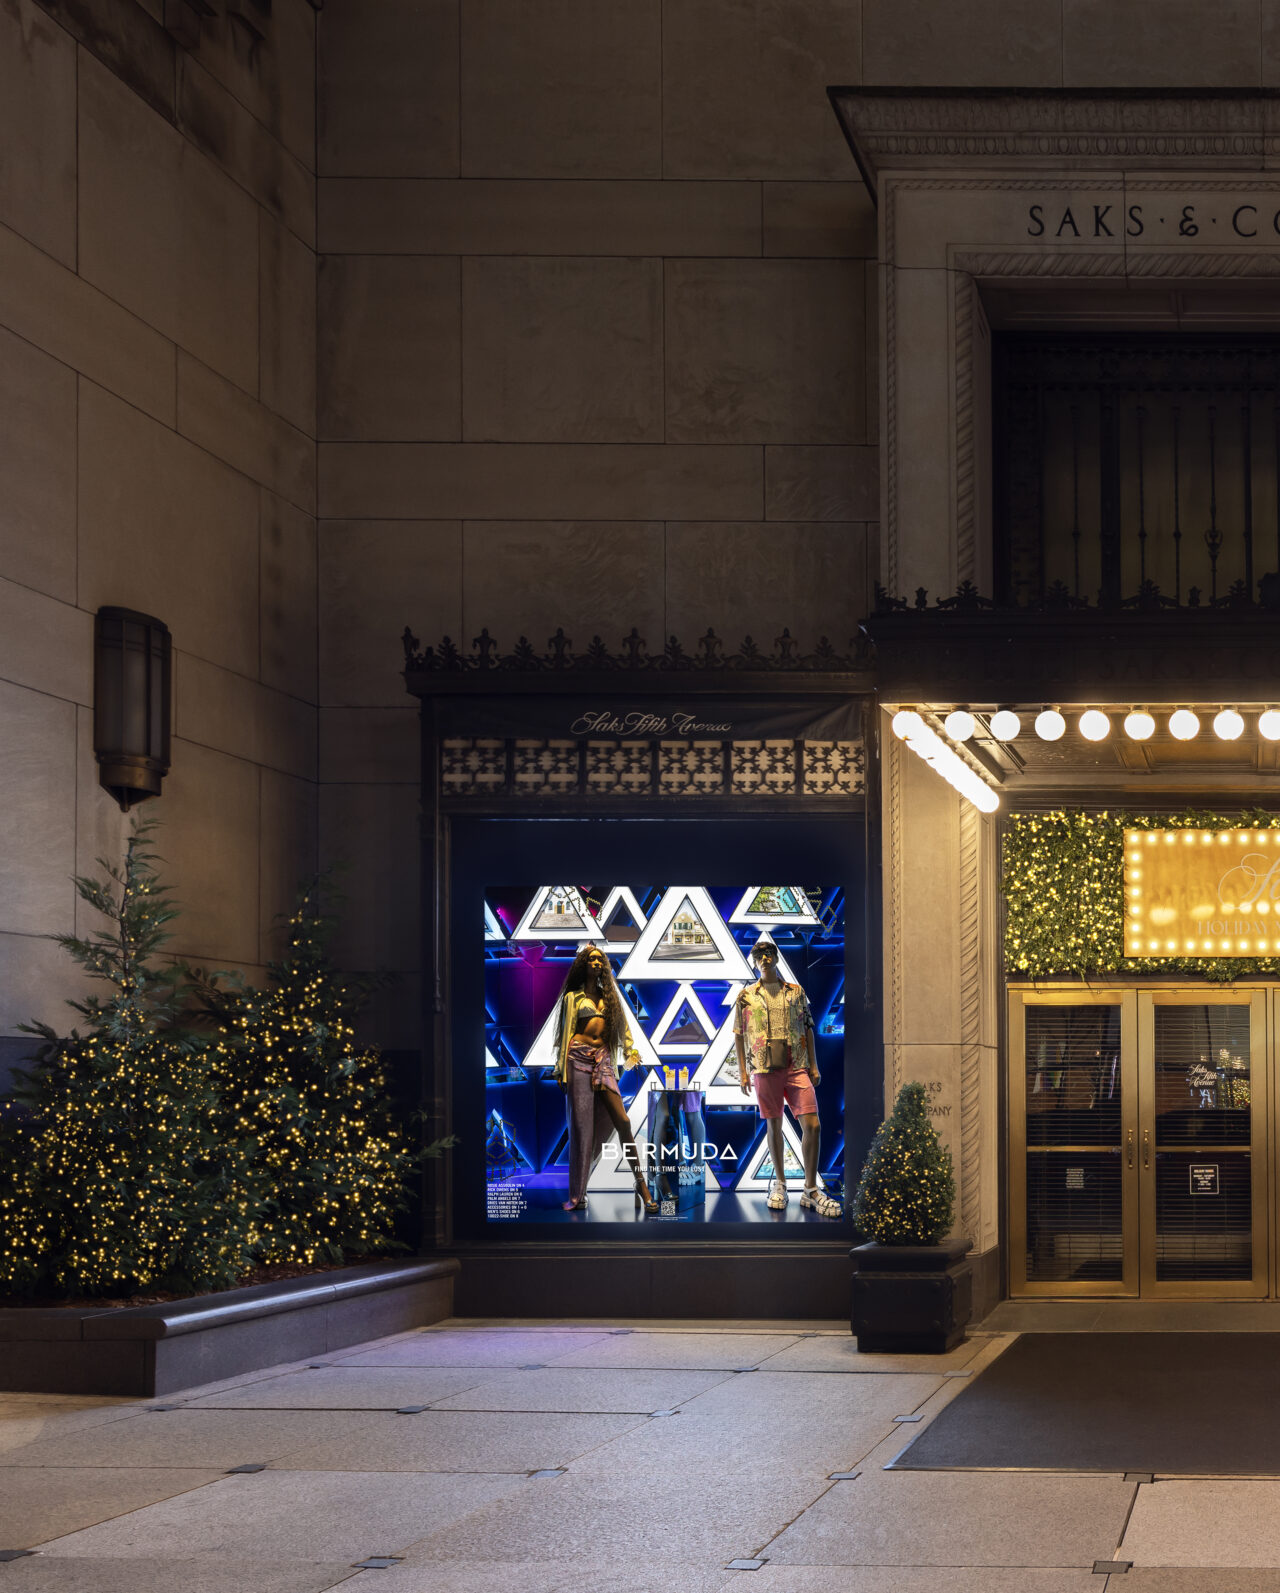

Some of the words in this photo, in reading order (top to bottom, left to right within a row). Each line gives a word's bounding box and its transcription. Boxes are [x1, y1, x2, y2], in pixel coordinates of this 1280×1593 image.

[1027, 205, 1144, 238] SAKS
[570, 711, 624, 735] Saks
[616, 712, 667, 736] Fifth
[655, 712, 732, 736] Avenue
[1198, 920, 1268, 935] HOLIDAY
[922, 1082, 942, 1092] AKS
[926, 1105, 952, 1116] PANY
[602, 1142, 738, 1160] BERMUDA
[634, 1165, 648, 1173] FIND
[649, 1165, 660, 1173] THE
[661, 1165, 676, 1173] TIME
[677, 1165, 690, 1173] YOU
[690, 1165, 706, 1173] LOST
